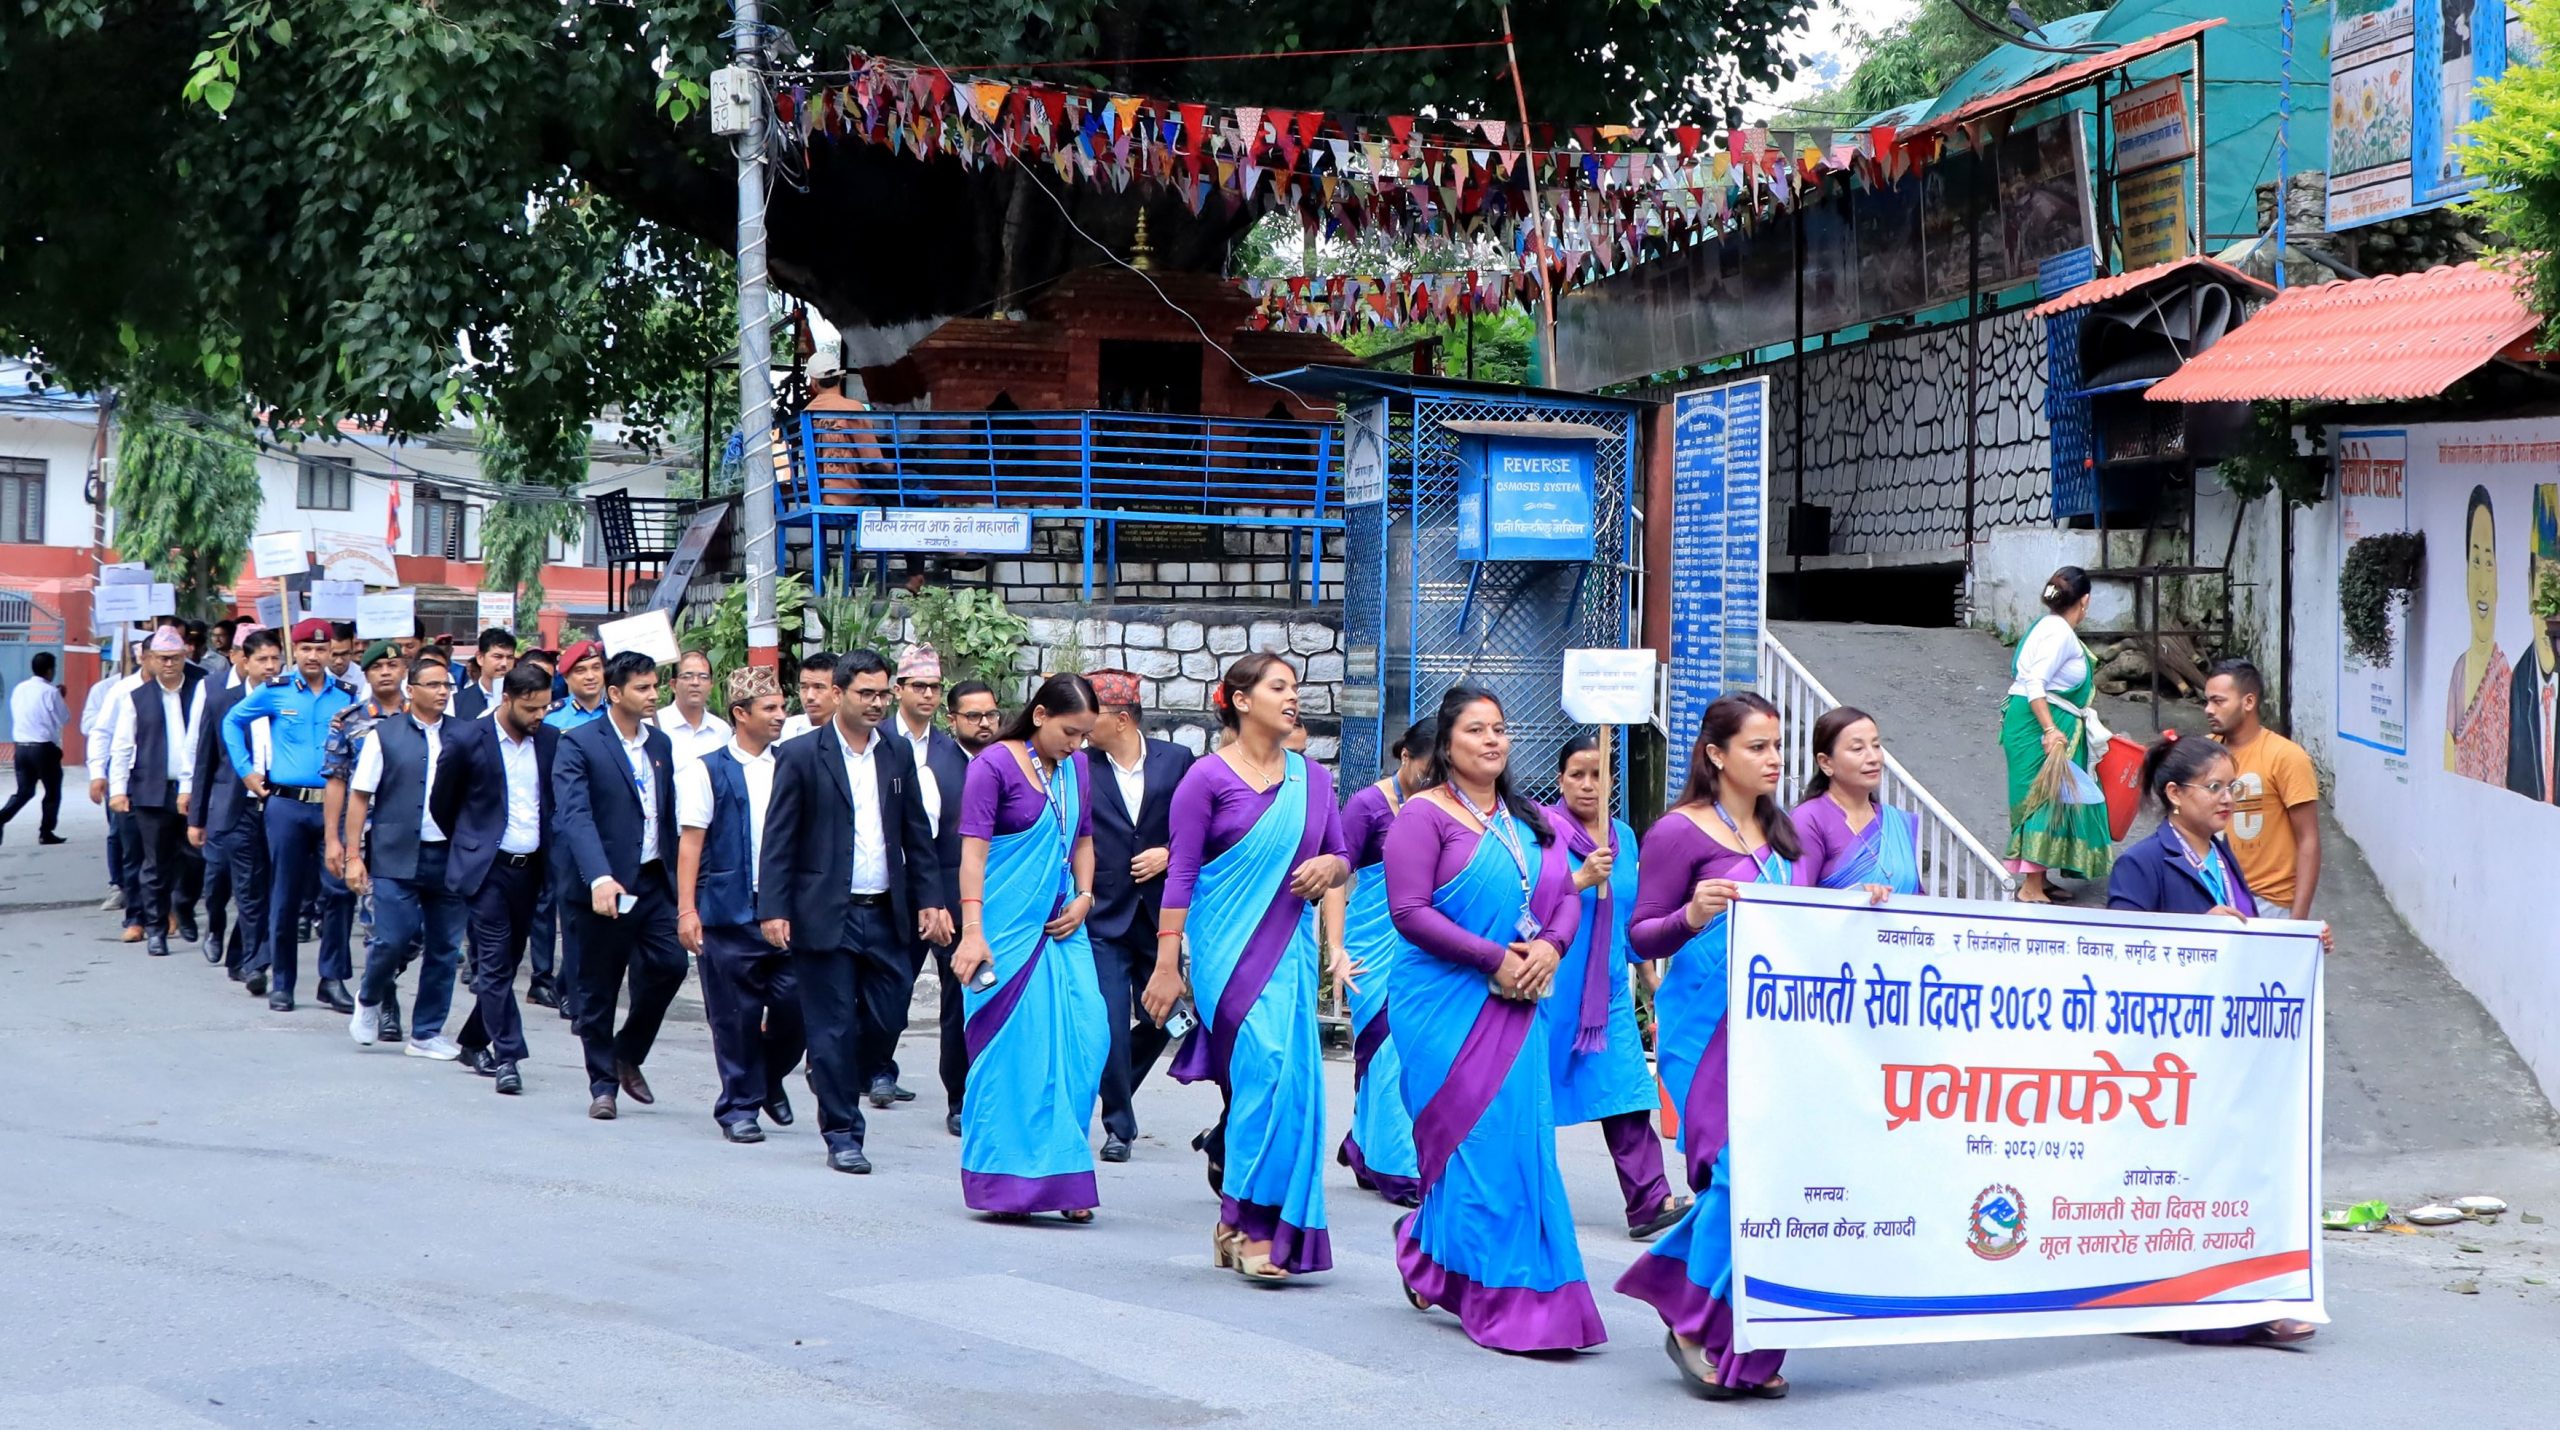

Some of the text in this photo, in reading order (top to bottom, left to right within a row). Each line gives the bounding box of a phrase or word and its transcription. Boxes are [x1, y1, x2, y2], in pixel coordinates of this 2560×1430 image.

[1504, 457, 1571, 473] REVERSE
[1496, 481, 1580, 492] OSMOSIS SYSTEM
[976, 516, 1020, 536] महारानी
[1877, 926, 1935, 947] व्यवसायिक
[1953, 934, 1961, 951] र
[1968, 930, 2020, 954] सिर्जनशील
[2077, 936, 2117, 962] विकास,
[2163, 947, 2171, 963] र
[2177, 947, 2218, 967] सुशासन
[1746, 954, 2305, 1041] निजामती सेवा दिवस २०८२ को अवसरमा आयोजित
[1880, 1050, 2197, 1131] प्रभातफेरी
[2004, 1139, 2084, 1160] २०८२/०५/२२
[2052, 1195, 2249, 1221] निजामती सेवा दिवस २०८२
[1740, 1217, 1781, 1240] र्मचारी
[1786, 1217, 1828, 1239] मिलन
[1873, 1216, 1916, 1238] म्याग्दी
[2039, 1236, 2072, 1261] मूल
[2077, 1229, 2140, 1255] समारोह
[2202, 1226, 2256, 1251] म्याग्दी
